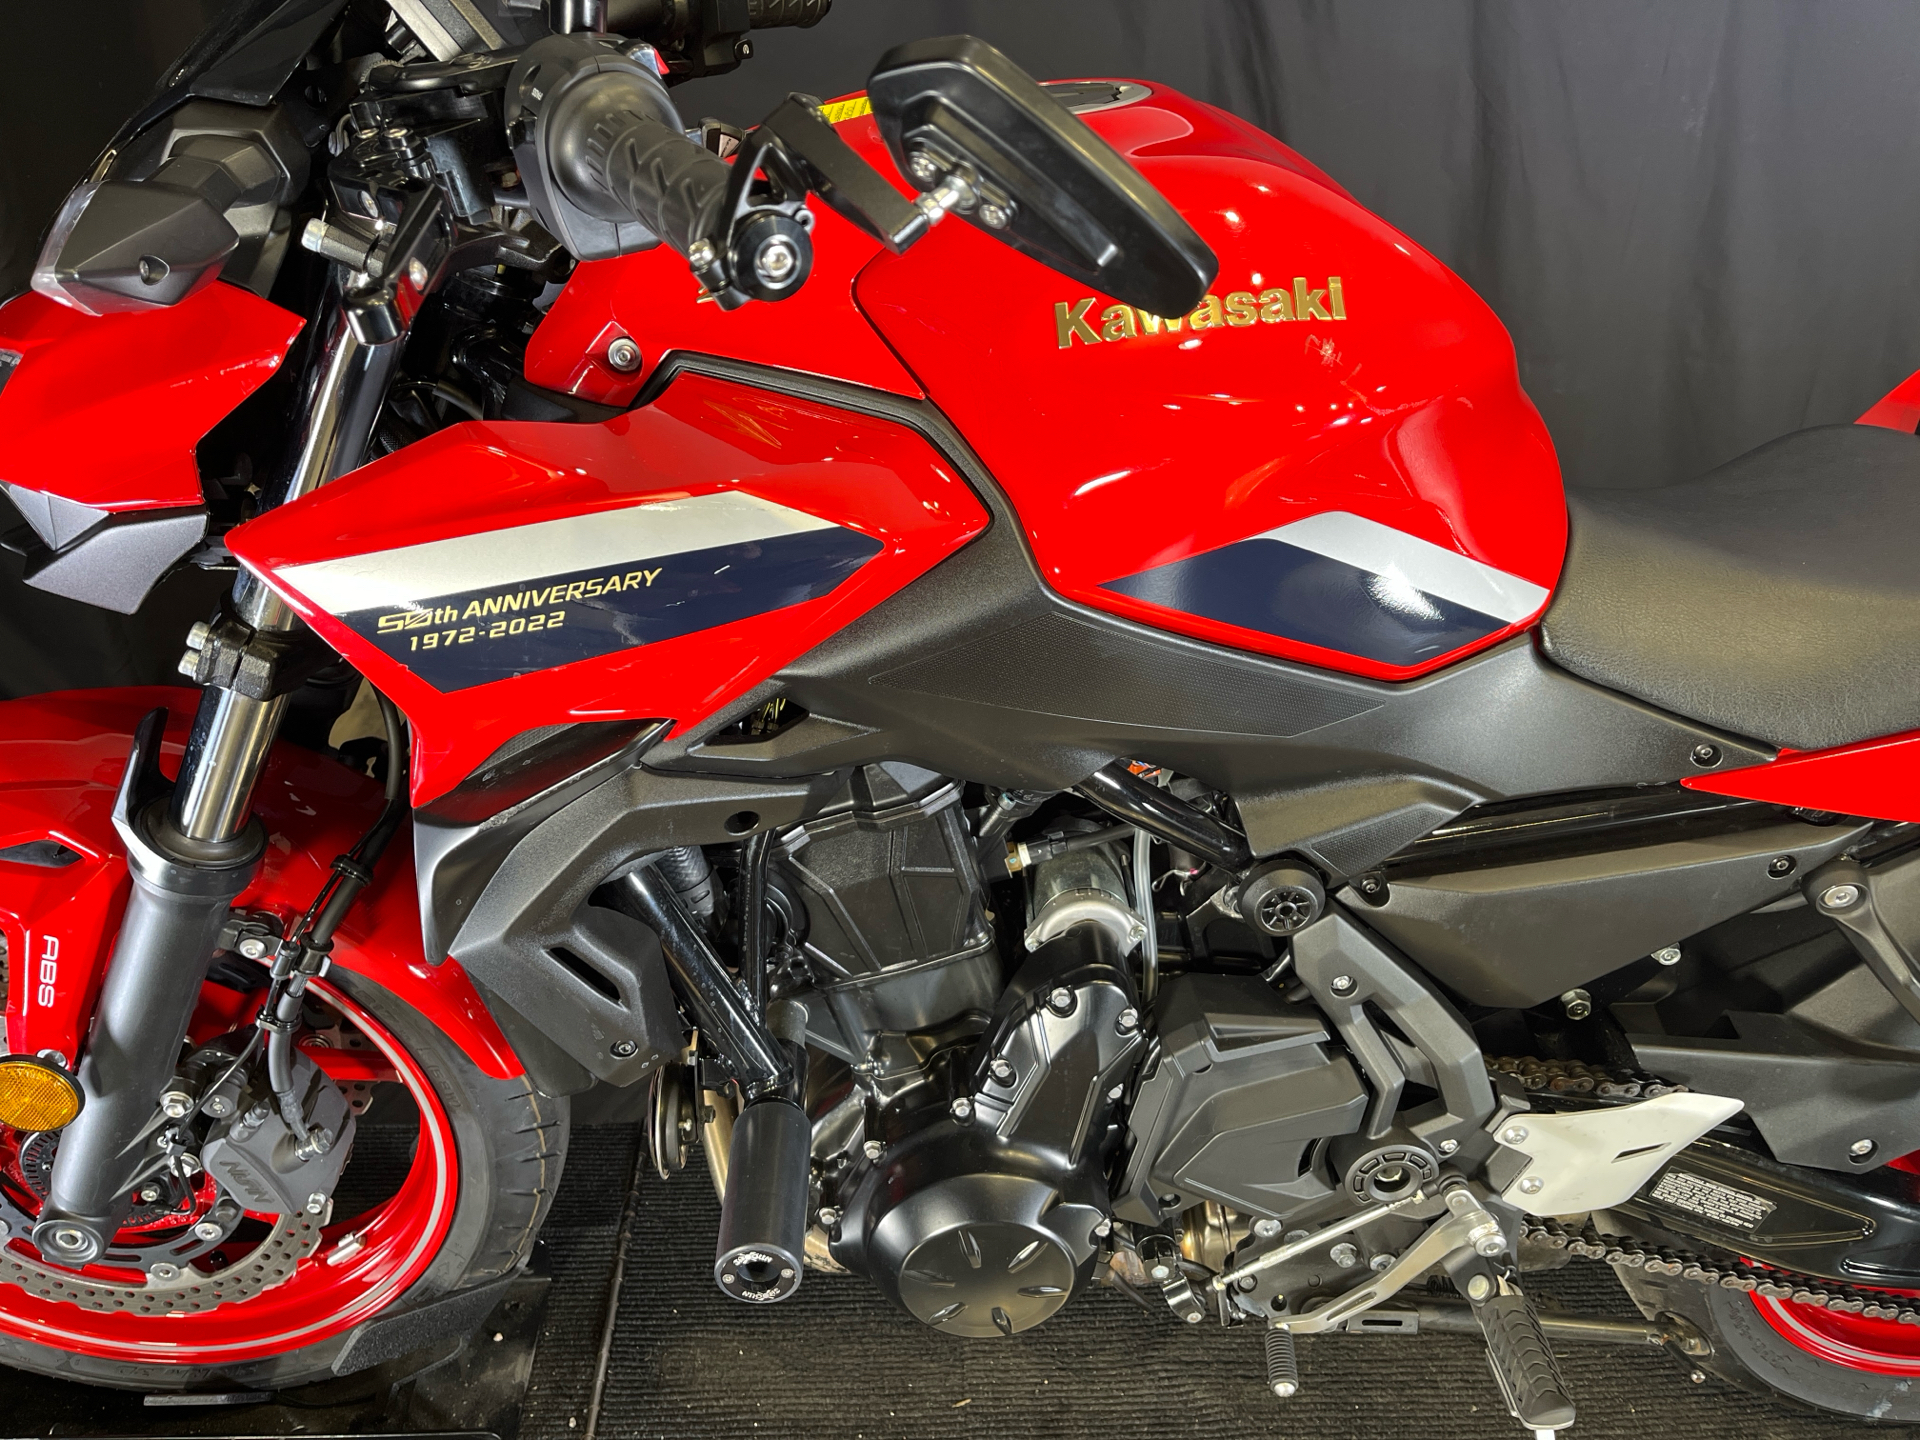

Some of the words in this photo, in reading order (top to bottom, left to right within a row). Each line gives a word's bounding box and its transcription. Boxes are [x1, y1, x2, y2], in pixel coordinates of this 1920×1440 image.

[377, 606, 459, 634] 50th
[461, 567, 662, 619] ANNIVERSARY
[410, 610, 566, 651] 1972-2022
[37, 934, 60, 1008] ABS
